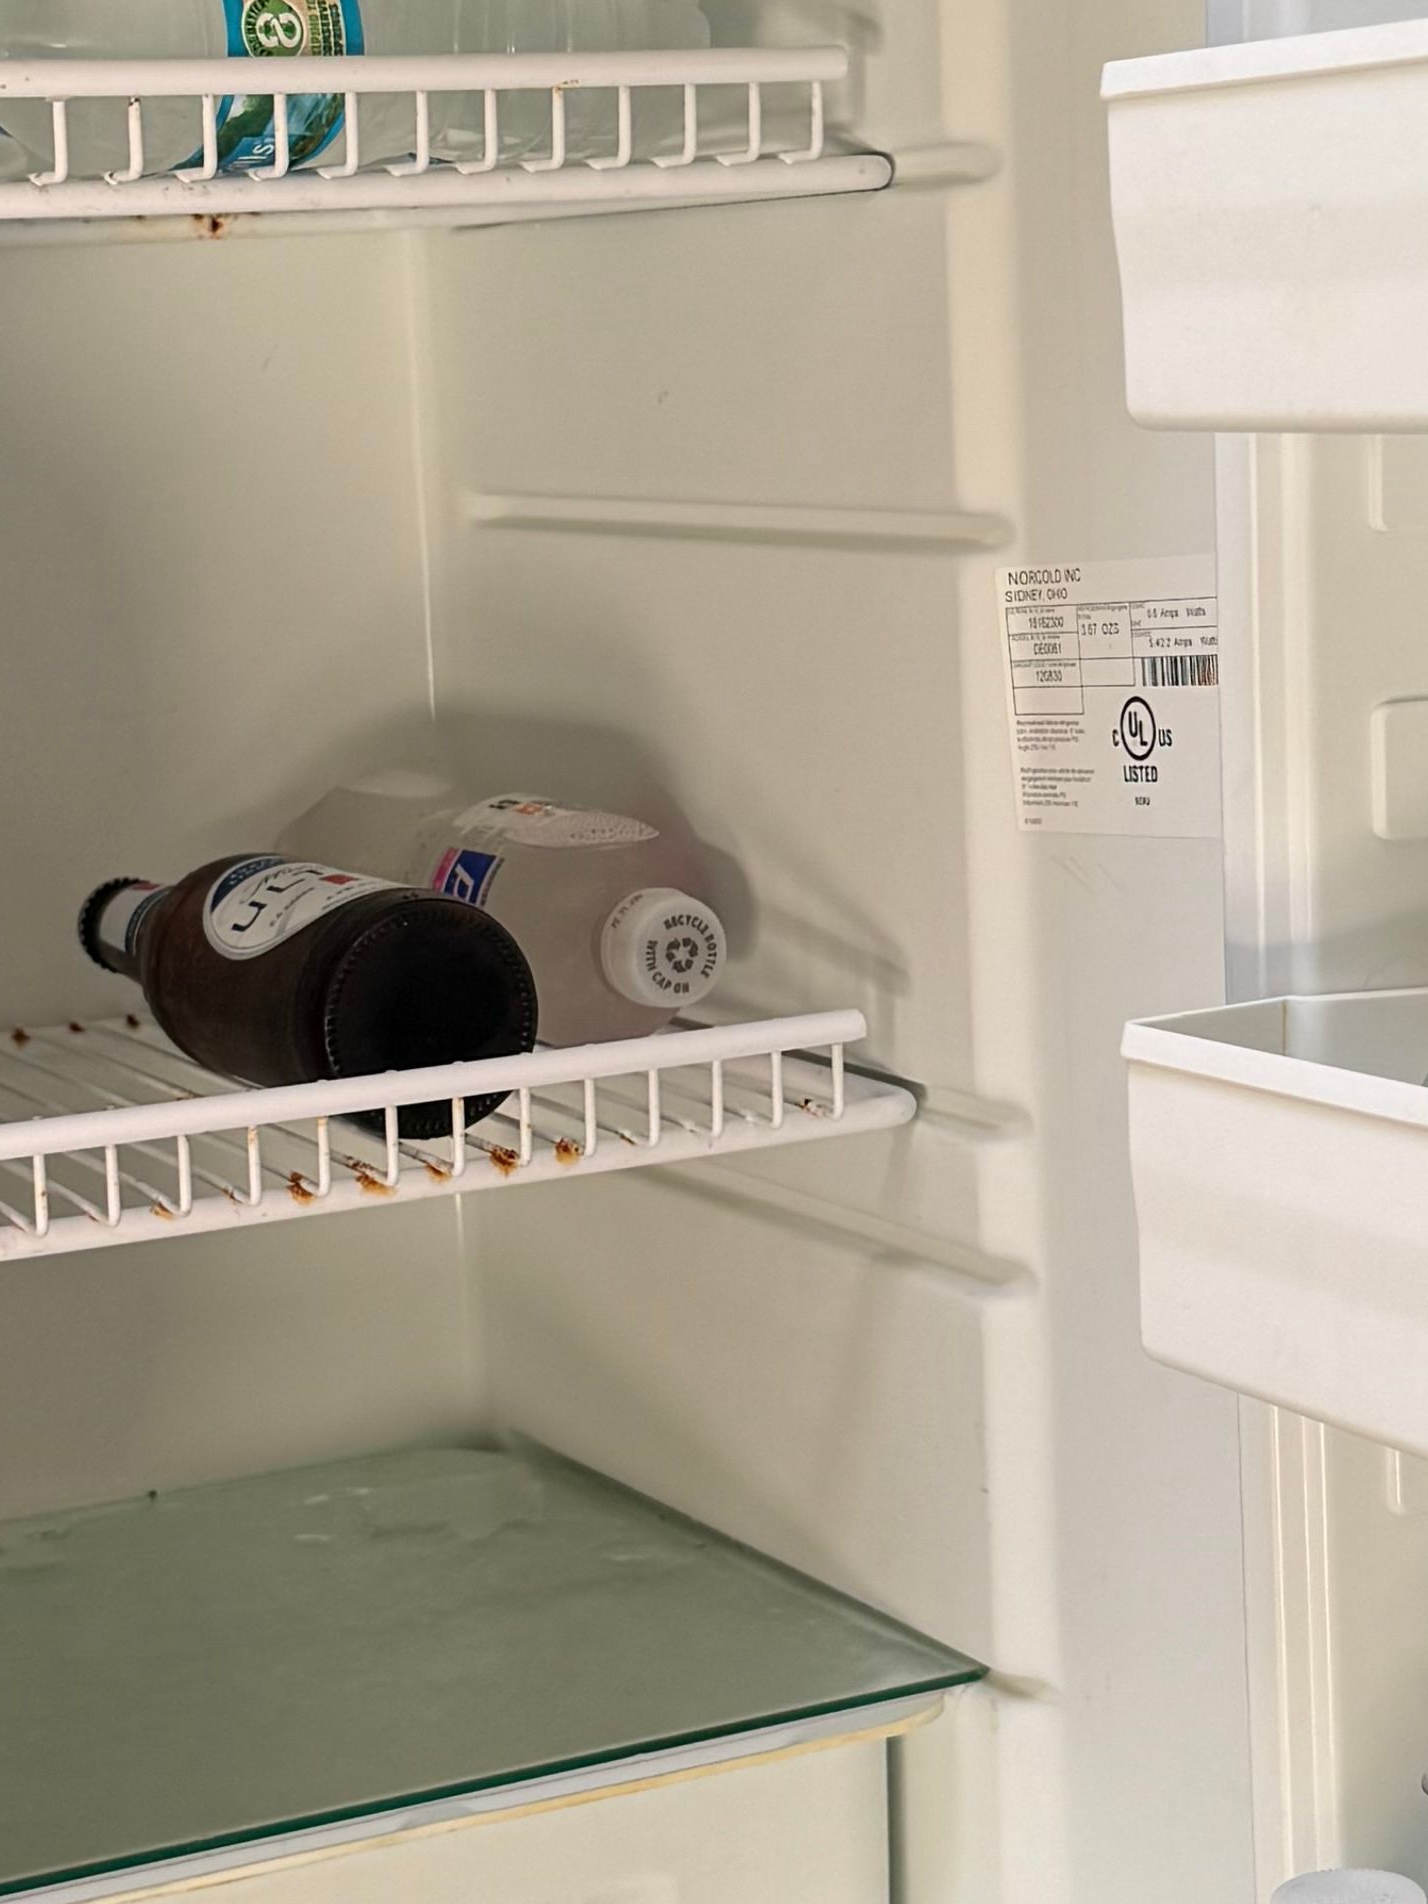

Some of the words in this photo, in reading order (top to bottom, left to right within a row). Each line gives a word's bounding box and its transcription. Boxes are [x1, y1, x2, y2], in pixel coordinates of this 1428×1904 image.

[1008, 570, 1062, 585] NORCOLD
[1065, 568, 1081, 583] INC
[1047, 588, 1068, 600] OHIO
[1128, 711, 1148, 746] UL
[1158, 729, 1173, 747] US
[1124, 765, 1158, 783] LISTED
[651, 971, 673, 992] CAP
